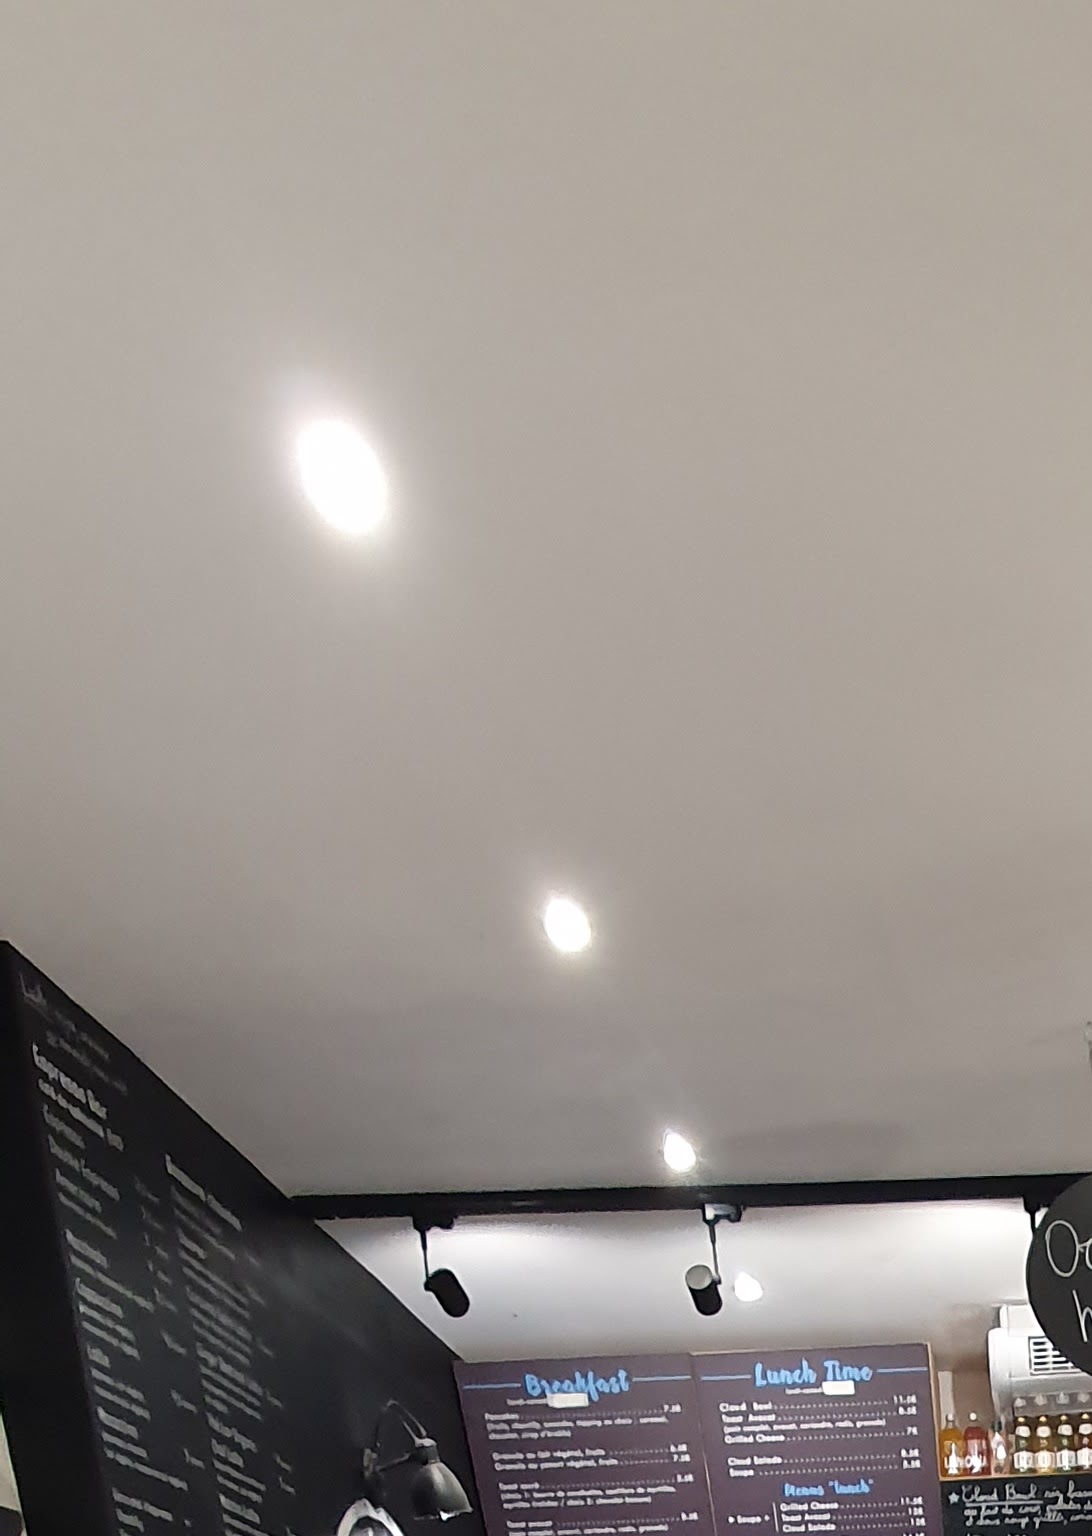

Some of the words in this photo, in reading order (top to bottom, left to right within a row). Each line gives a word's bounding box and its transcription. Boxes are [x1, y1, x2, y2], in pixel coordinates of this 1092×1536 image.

[524, 1369, 629, 1402] Breakfast
[754, 1357, 817, 1387] Lunch
[823, 1359, 873, 1382] Time
